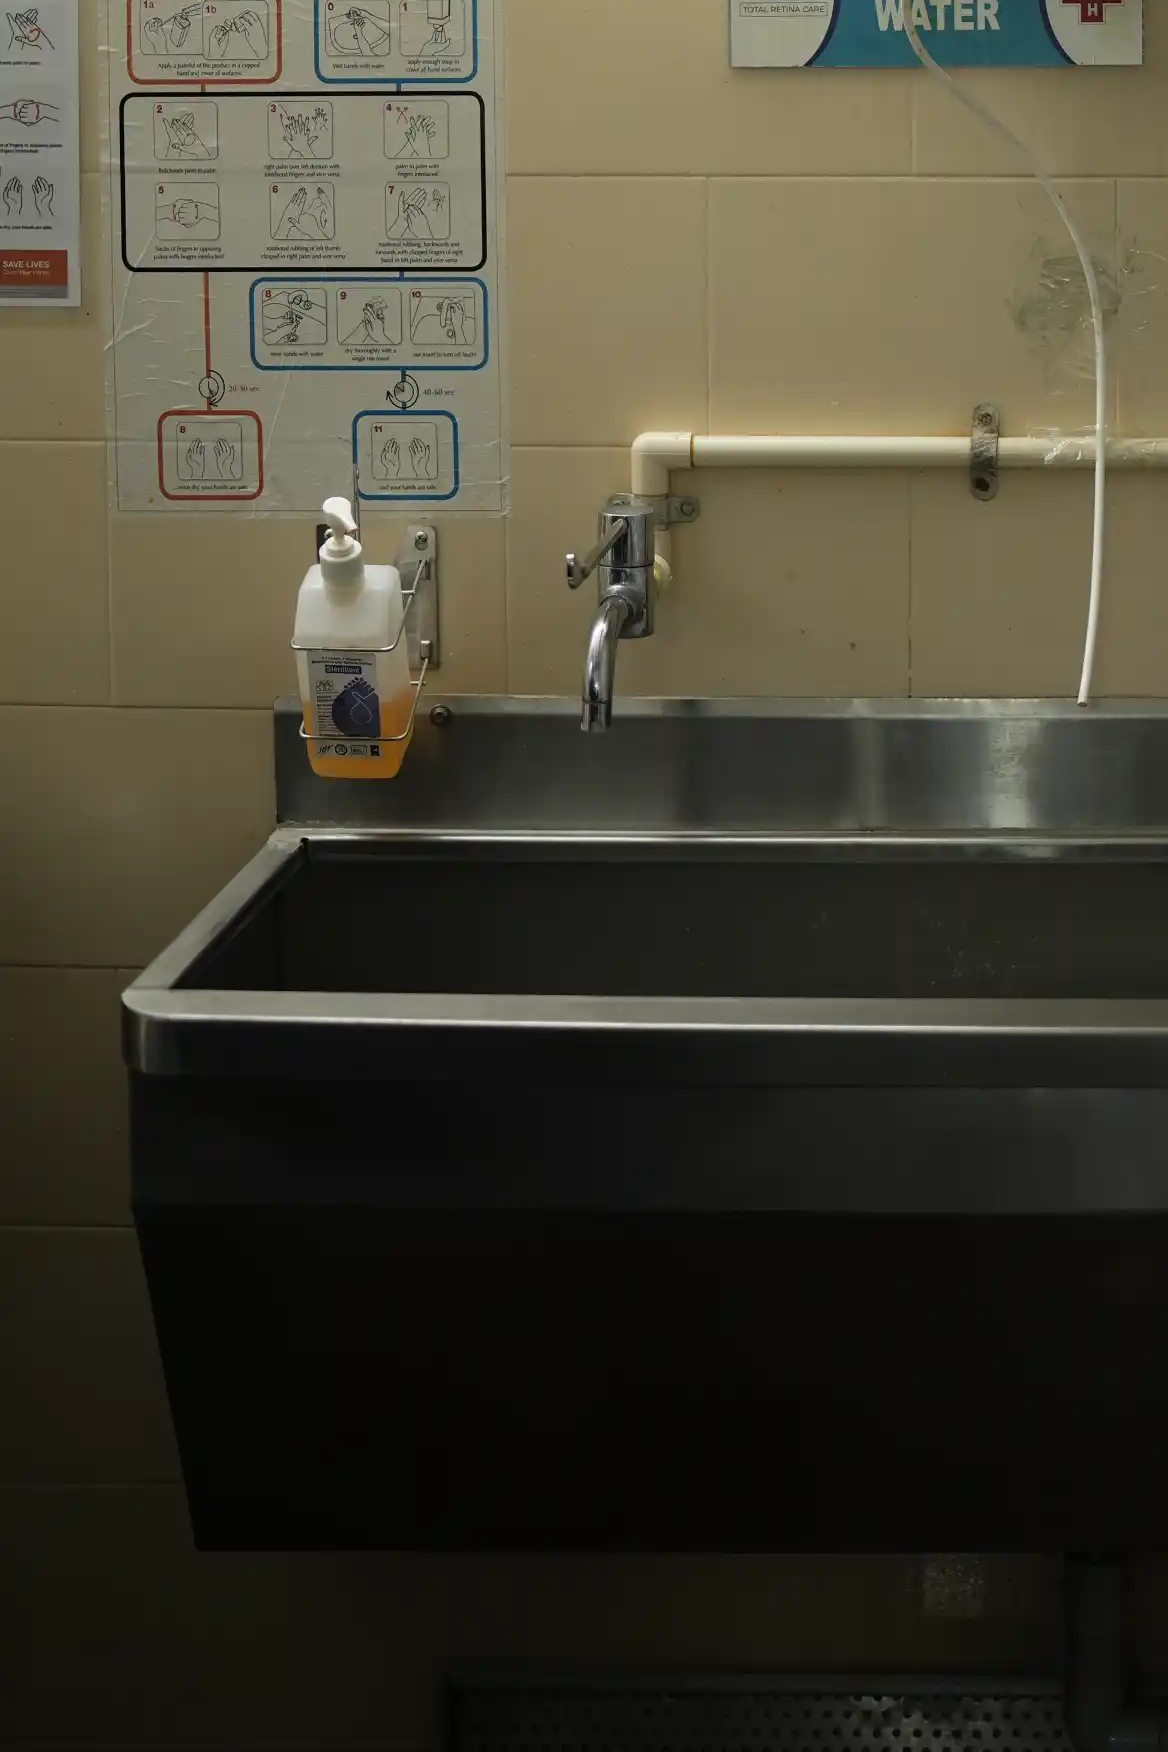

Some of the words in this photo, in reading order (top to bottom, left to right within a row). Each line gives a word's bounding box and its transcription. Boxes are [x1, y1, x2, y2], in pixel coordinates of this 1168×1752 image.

[143, 0, 154, 8] 1a
[402, 2, 408, 11] 1
[205, 5, 217, 13] 1b
[743, 5, 768, 13] TOTAL
[769, 5, 800, 13] RETINA
[803, 5, 825, 13] CARE
[1087, 3, 1098, 16] H
[156, 105, 163, 113] 2
[270, 104, 277, 112] 3
[386, 104, 393, 112] 4
[158, 186, 164, 194] 5
[272, 185, 278, 193] 6
[388, 186, 395, 194] 7
[340, 291, 347, 299] 9
